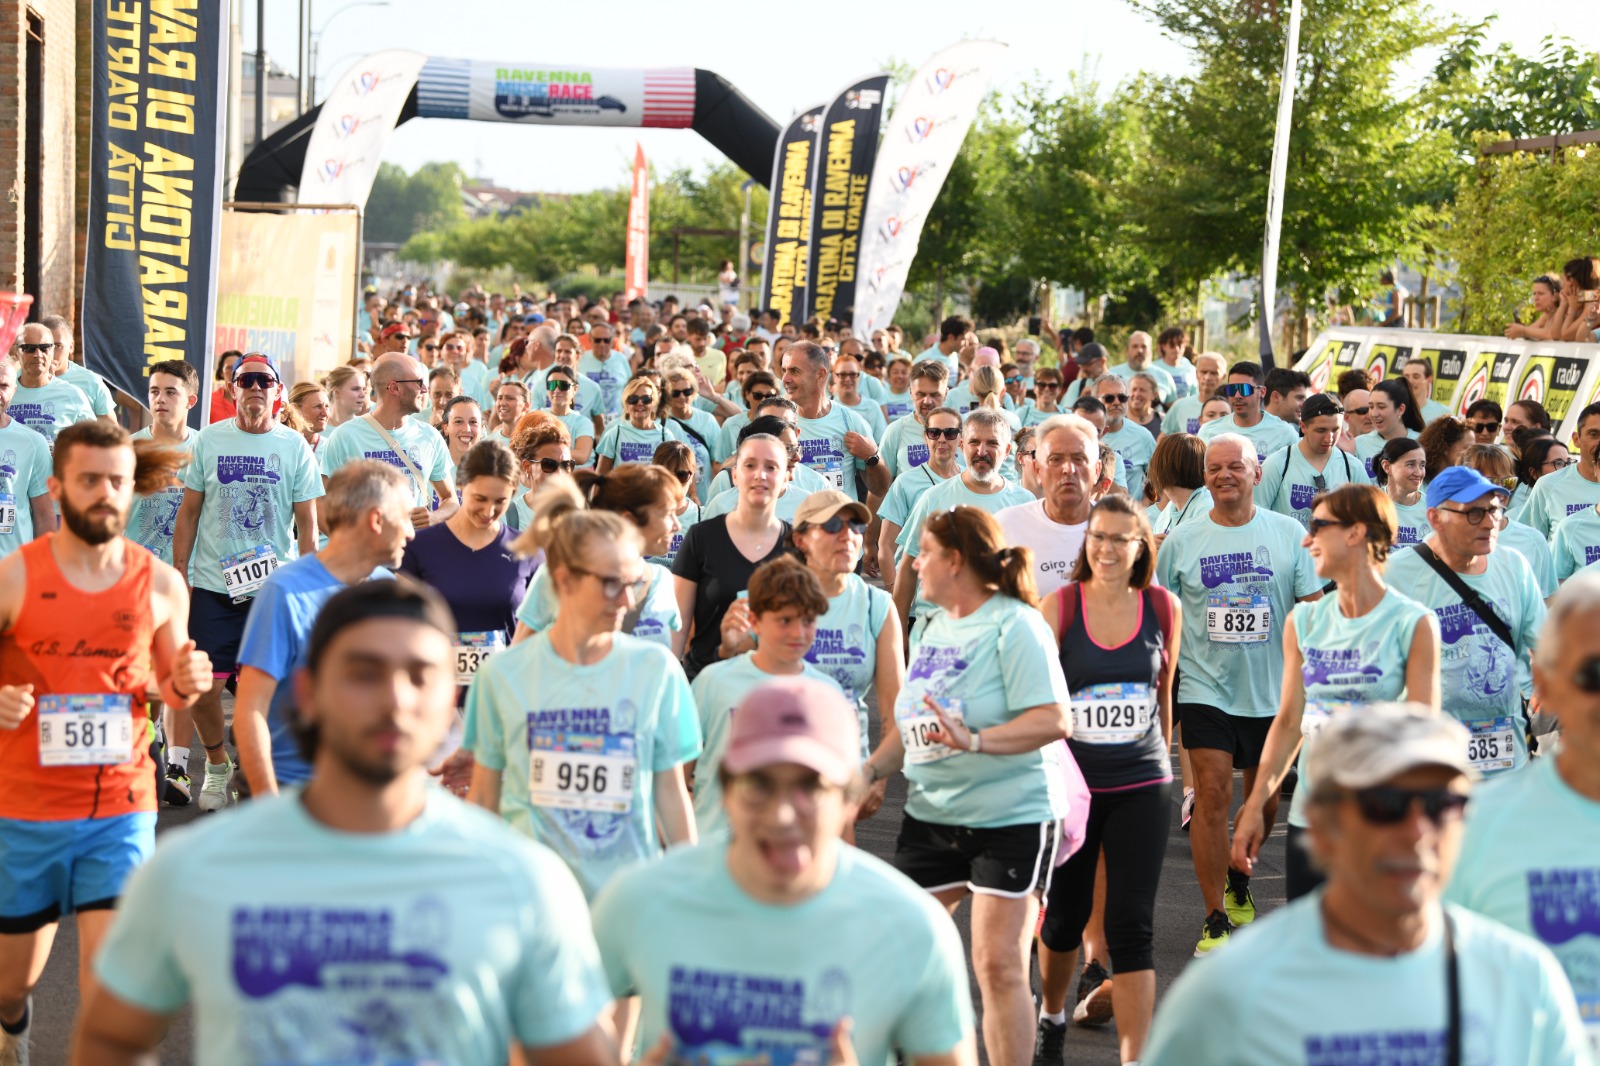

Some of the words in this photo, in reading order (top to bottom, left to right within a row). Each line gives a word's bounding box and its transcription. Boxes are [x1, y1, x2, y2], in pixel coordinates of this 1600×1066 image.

[496, 68, 592, 83] RAVENNA
[824, 119, 856, 207] RAVENNA
[779, 140, 810, 218] RAVENNA
[821, 209, 846, 230] DI
[1441, 354, 1461, 375] radio
[1556, 362, 1581, 385] radio
[798, 438, 830, 447] VENNA
[217, 455, 265, 465] RAVENNA
[1040, 560, 1066, 572] Giro
[1199, 551, 1253, 567] RAVENNA
[1201, 561, 1255, 575] MUSICRACE
[232, 560, 270, 584] 1107
[1224, 613, 1256, 632] 832
[527, 707, 611, 723] RAVENNA
[1083, 705, 1135, 728] 1029
[65, 720, 107, 747] 581
[1468, 737, 1499, 761] 585
[557, 761, 608, 793] 956
